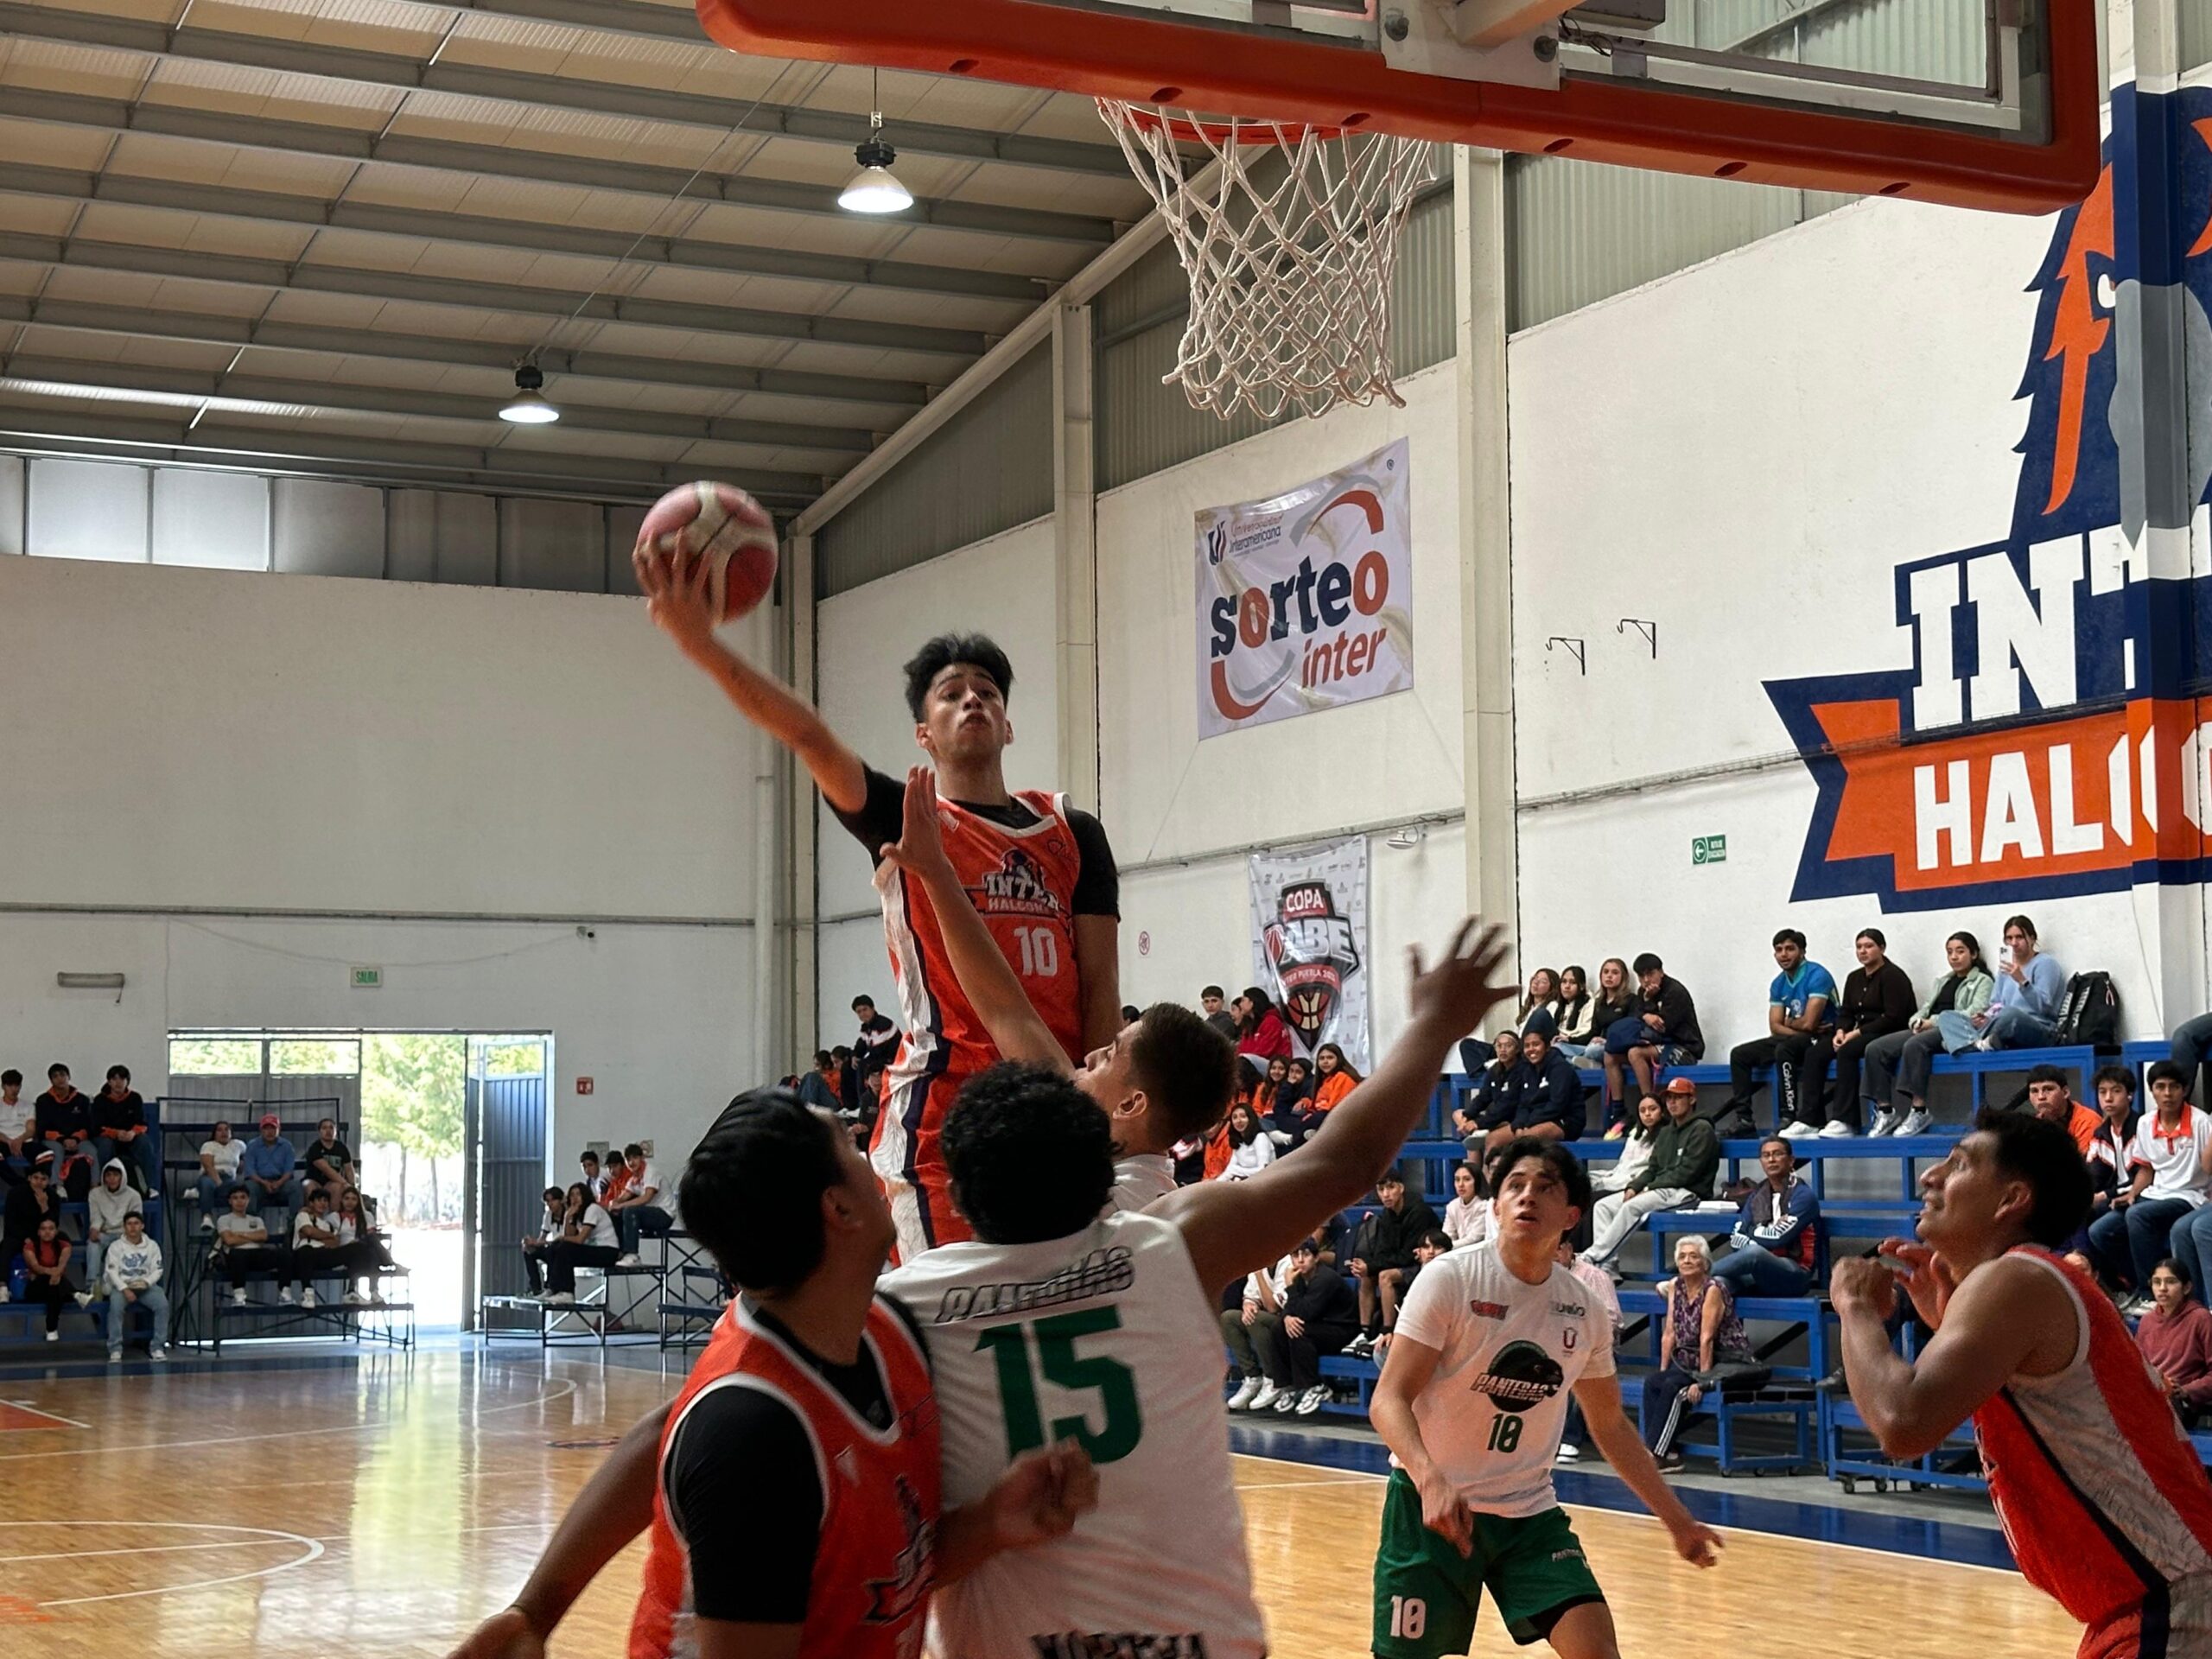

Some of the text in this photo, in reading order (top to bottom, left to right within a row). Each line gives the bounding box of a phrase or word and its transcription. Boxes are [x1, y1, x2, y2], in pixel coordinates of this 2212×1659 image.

[1211, 550, 1389, 658] sorteo
[1302, 628, 1387, 689] inter
[1286, 888, 1325, 913] COPA
[1014, 925, 1058, 977] 10
[972, 1305, 1143, 1464] 15
[1487, 1413, 1524, 1453] 10
[1389, 1593, 1427, 1640] 10
